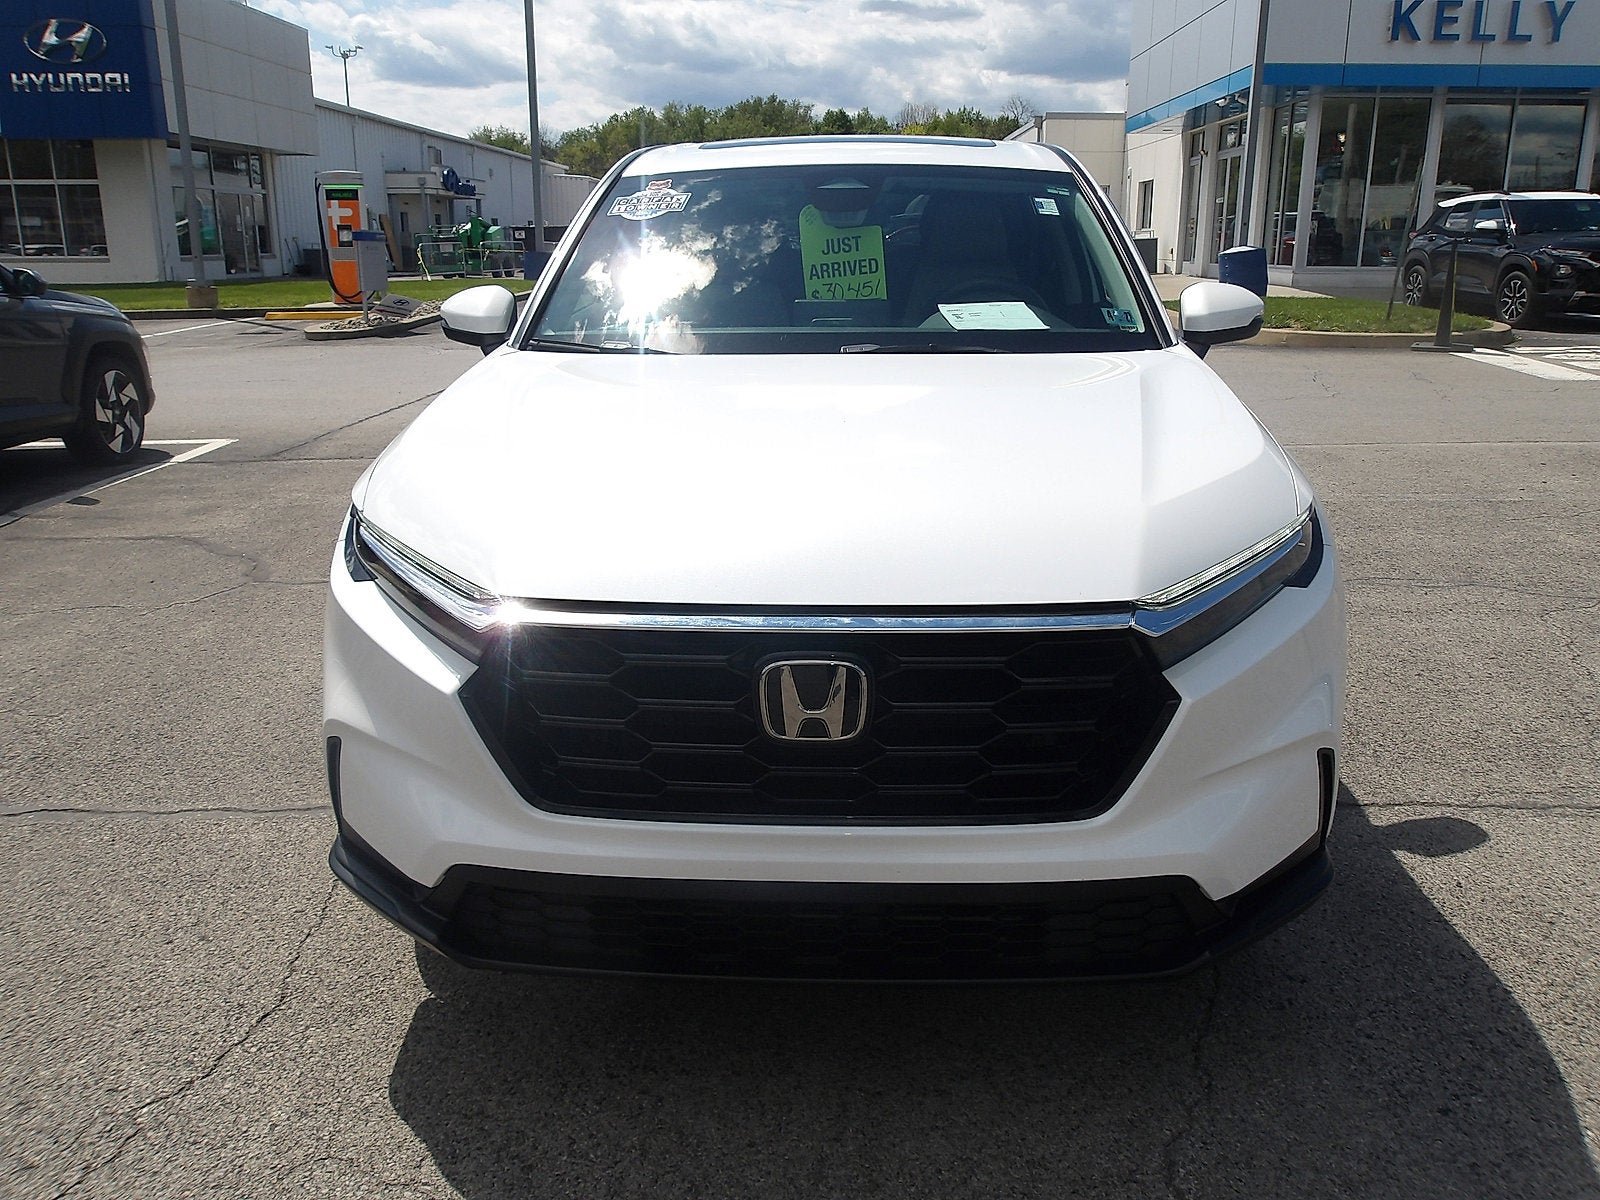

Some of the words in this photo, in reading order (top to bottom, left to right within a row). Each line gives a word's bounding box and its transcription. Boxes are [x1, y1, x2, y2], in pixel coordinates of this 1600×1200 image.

[1391, 0, 1576, 42] KELLY
[10, 72, 131, 93] HYUNDAI
[617, 195, 685, 206] CARFAX
[821, 236, 861, 256] JUST
[809, 258, 879, 280] ARRIVED
